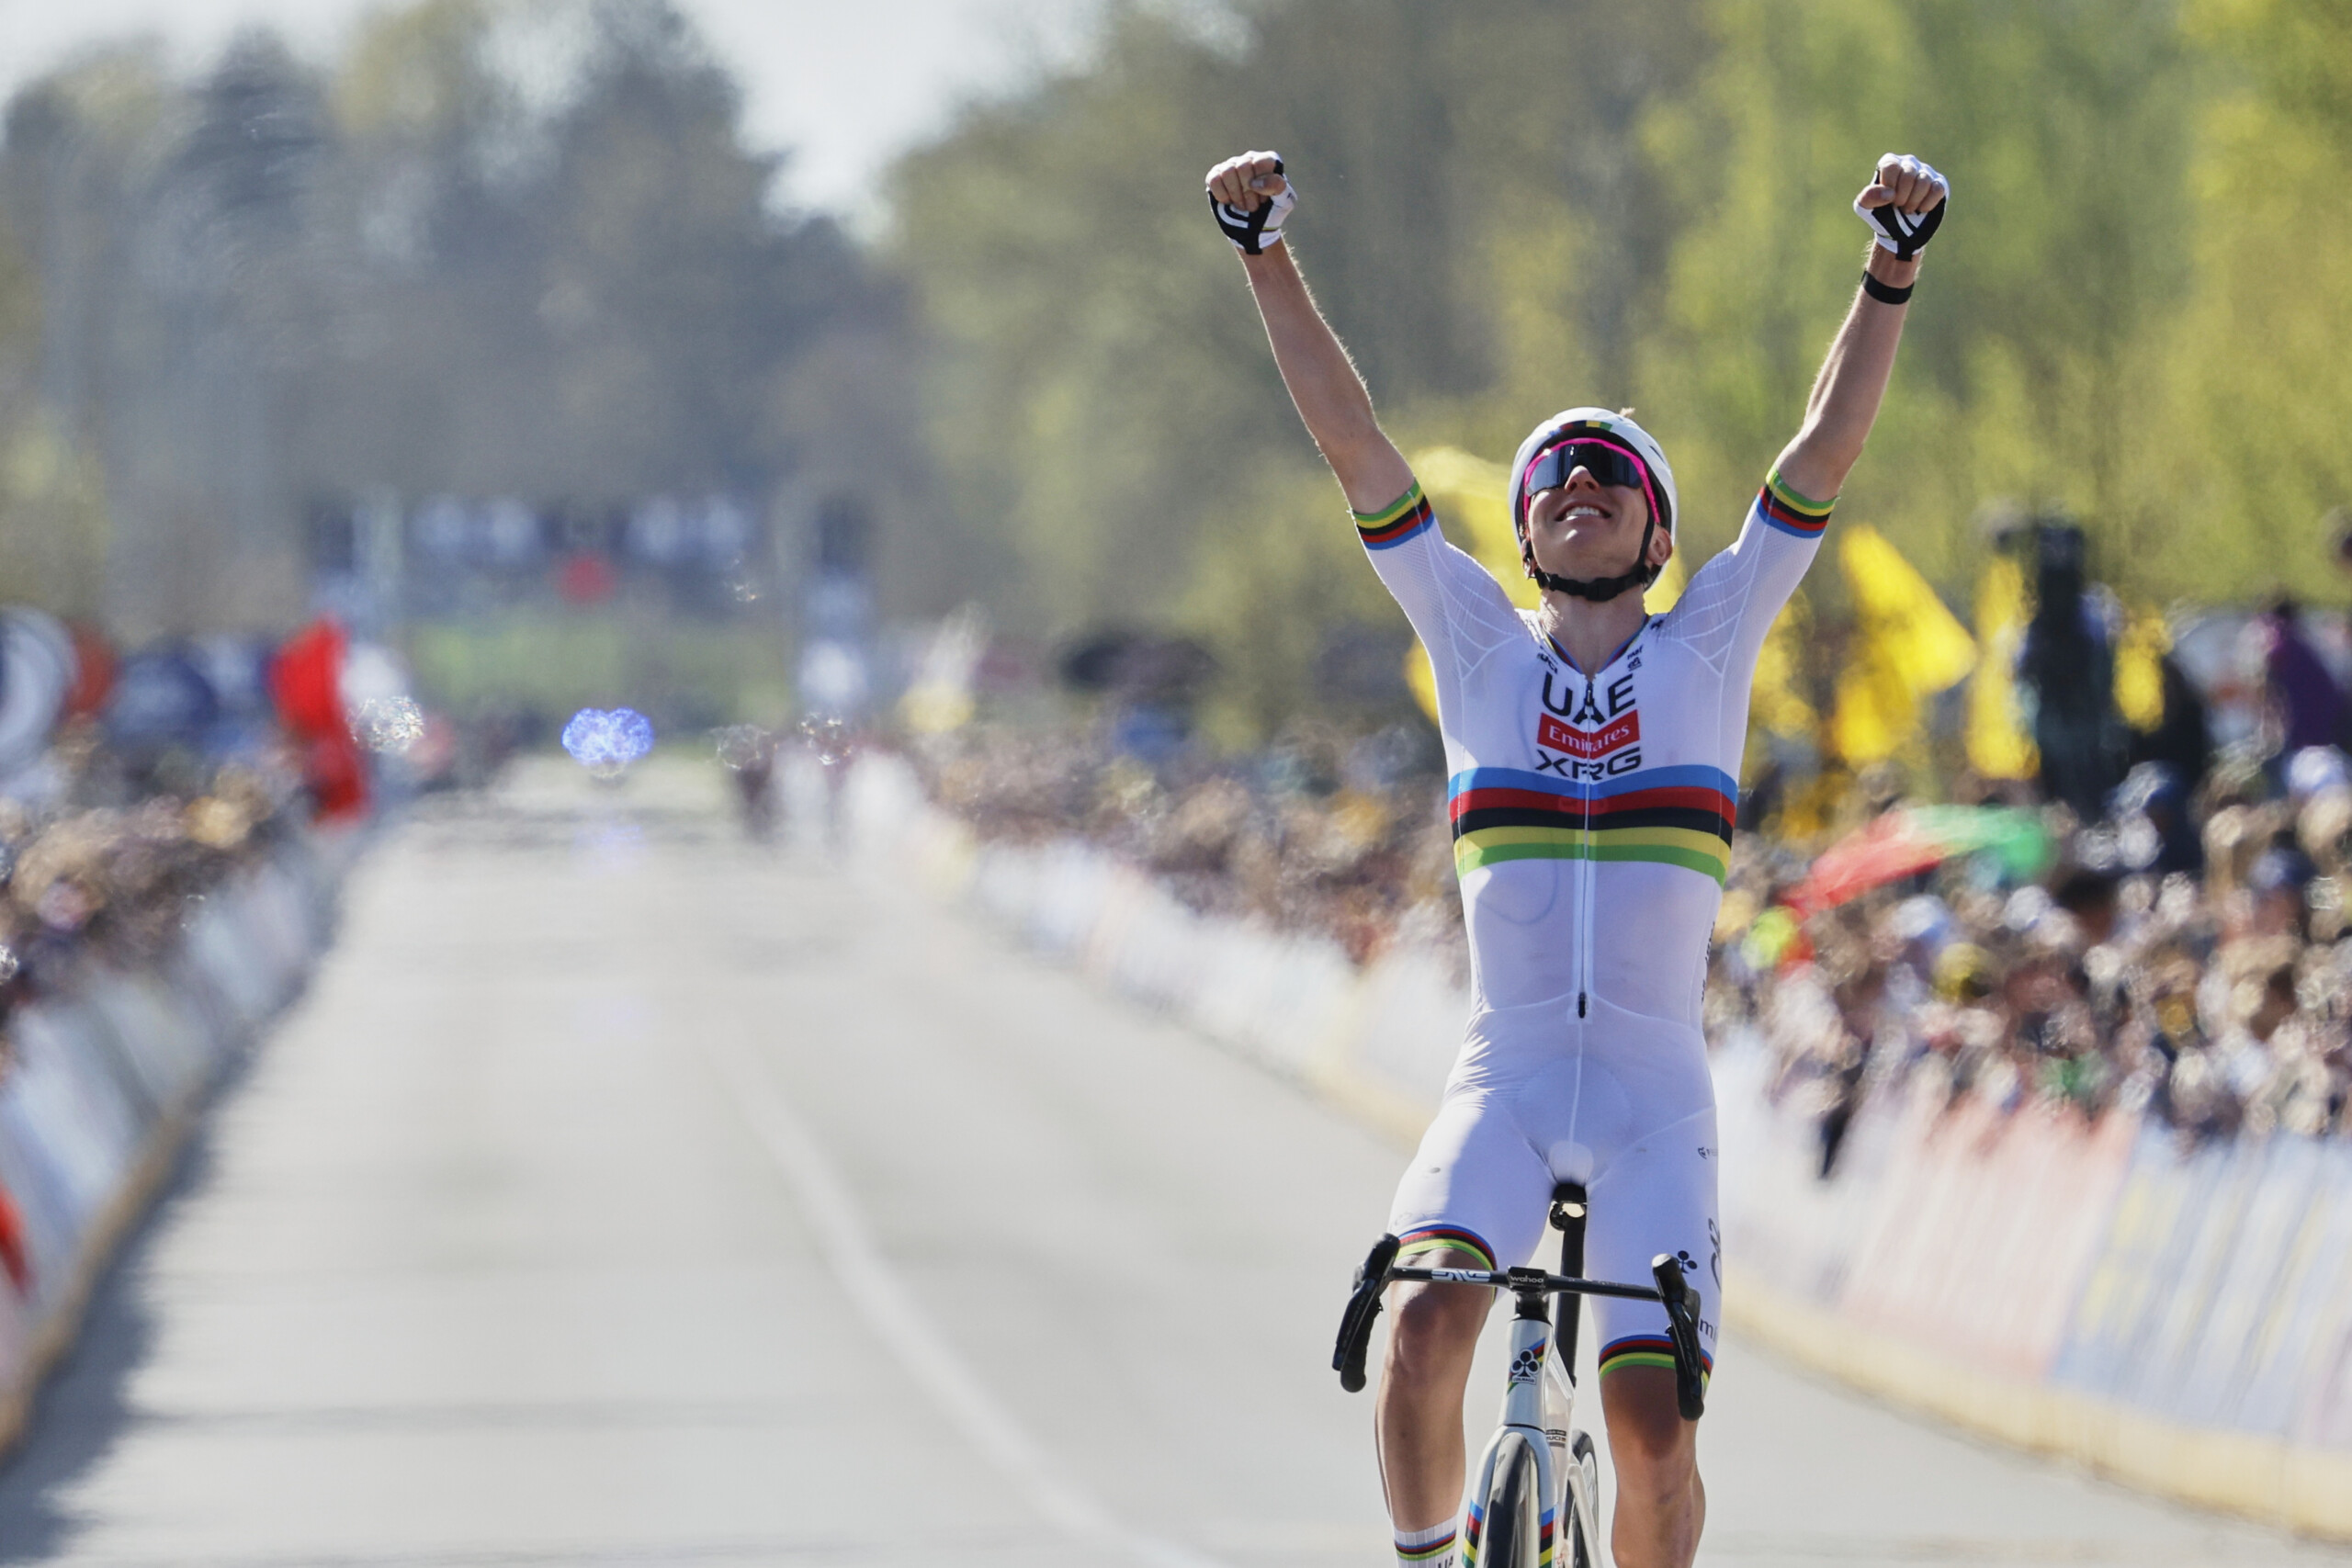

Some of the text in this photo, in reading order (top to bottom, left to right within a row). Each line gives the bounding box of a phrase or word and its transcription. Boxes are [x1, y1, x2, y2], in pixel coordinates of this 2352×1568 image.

[1542, 671, 1636, 725] UAE
[1549, 725, 1630, 752] Emirates
[1535, 747, 1642, 781] XRG
